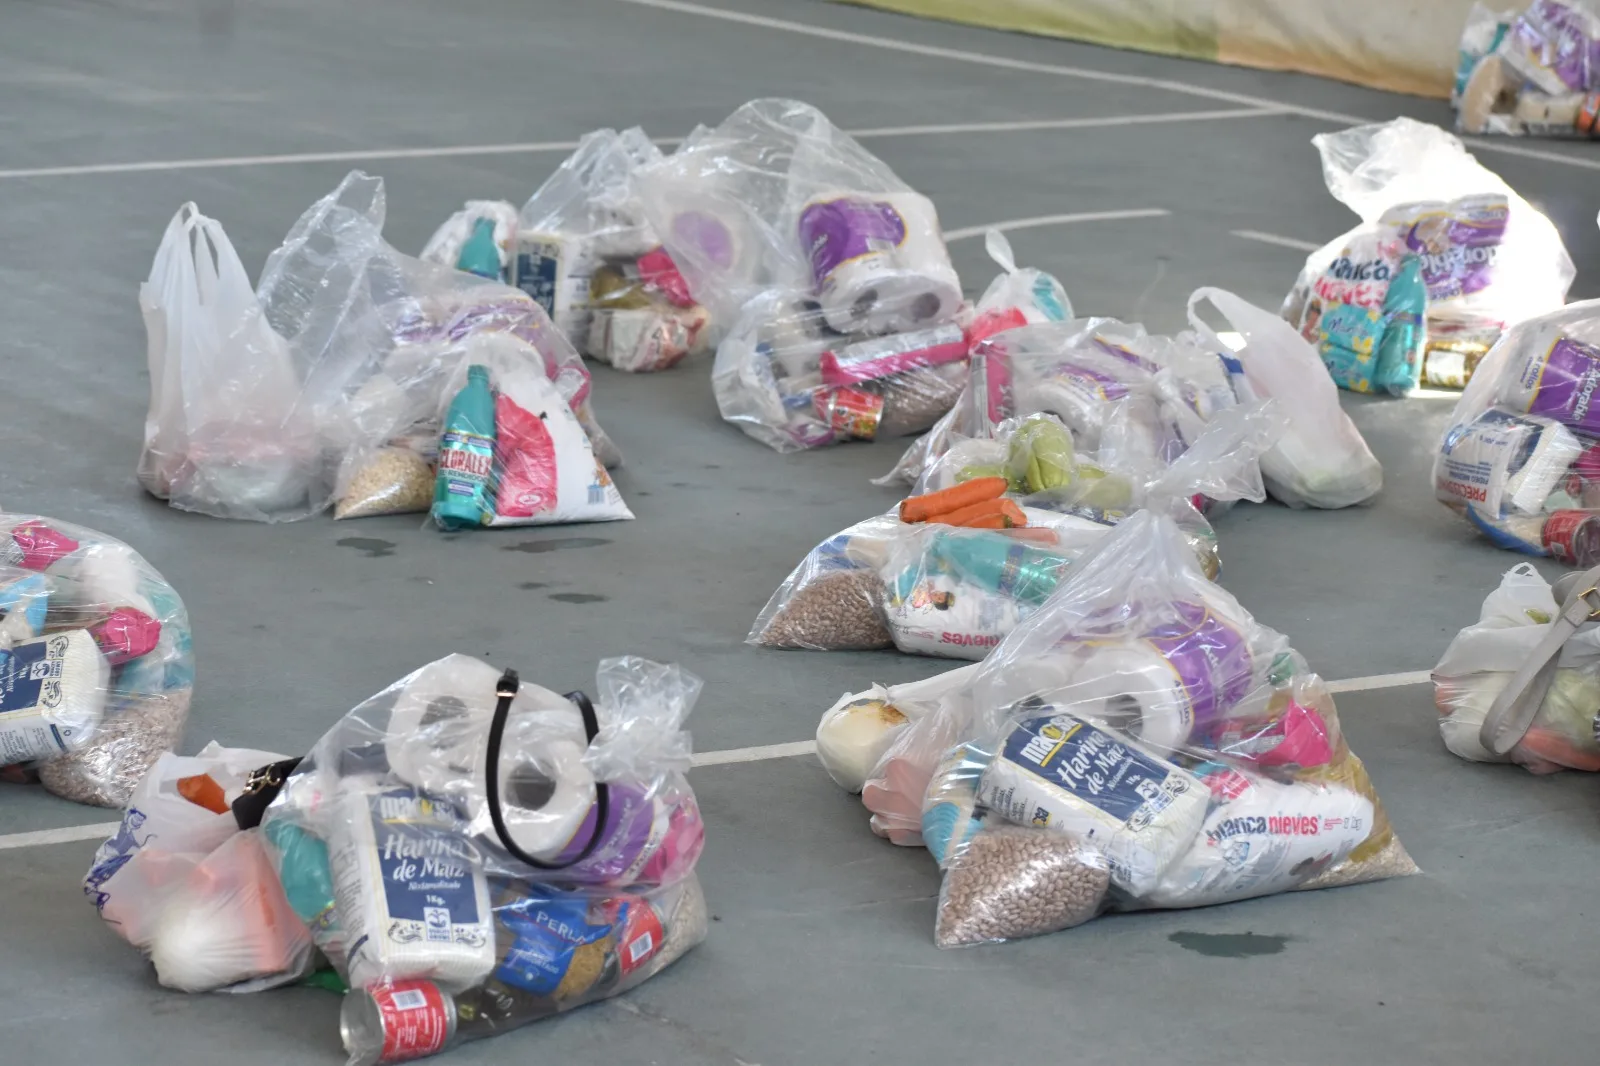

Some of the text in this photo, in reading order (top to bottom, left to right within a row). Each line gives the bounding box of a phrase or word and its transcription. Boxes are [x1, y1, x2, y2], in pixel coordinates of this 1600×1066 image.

[1057, 731, 1107, 789] Harina
[1087, 773, 1105, 795] de
[1206, 815, 1267, 842] blanca
[1269, 814, 1319, 836] nieves
[384, 834, 464, 861] Harina
[393, 859, 417, 882] de
